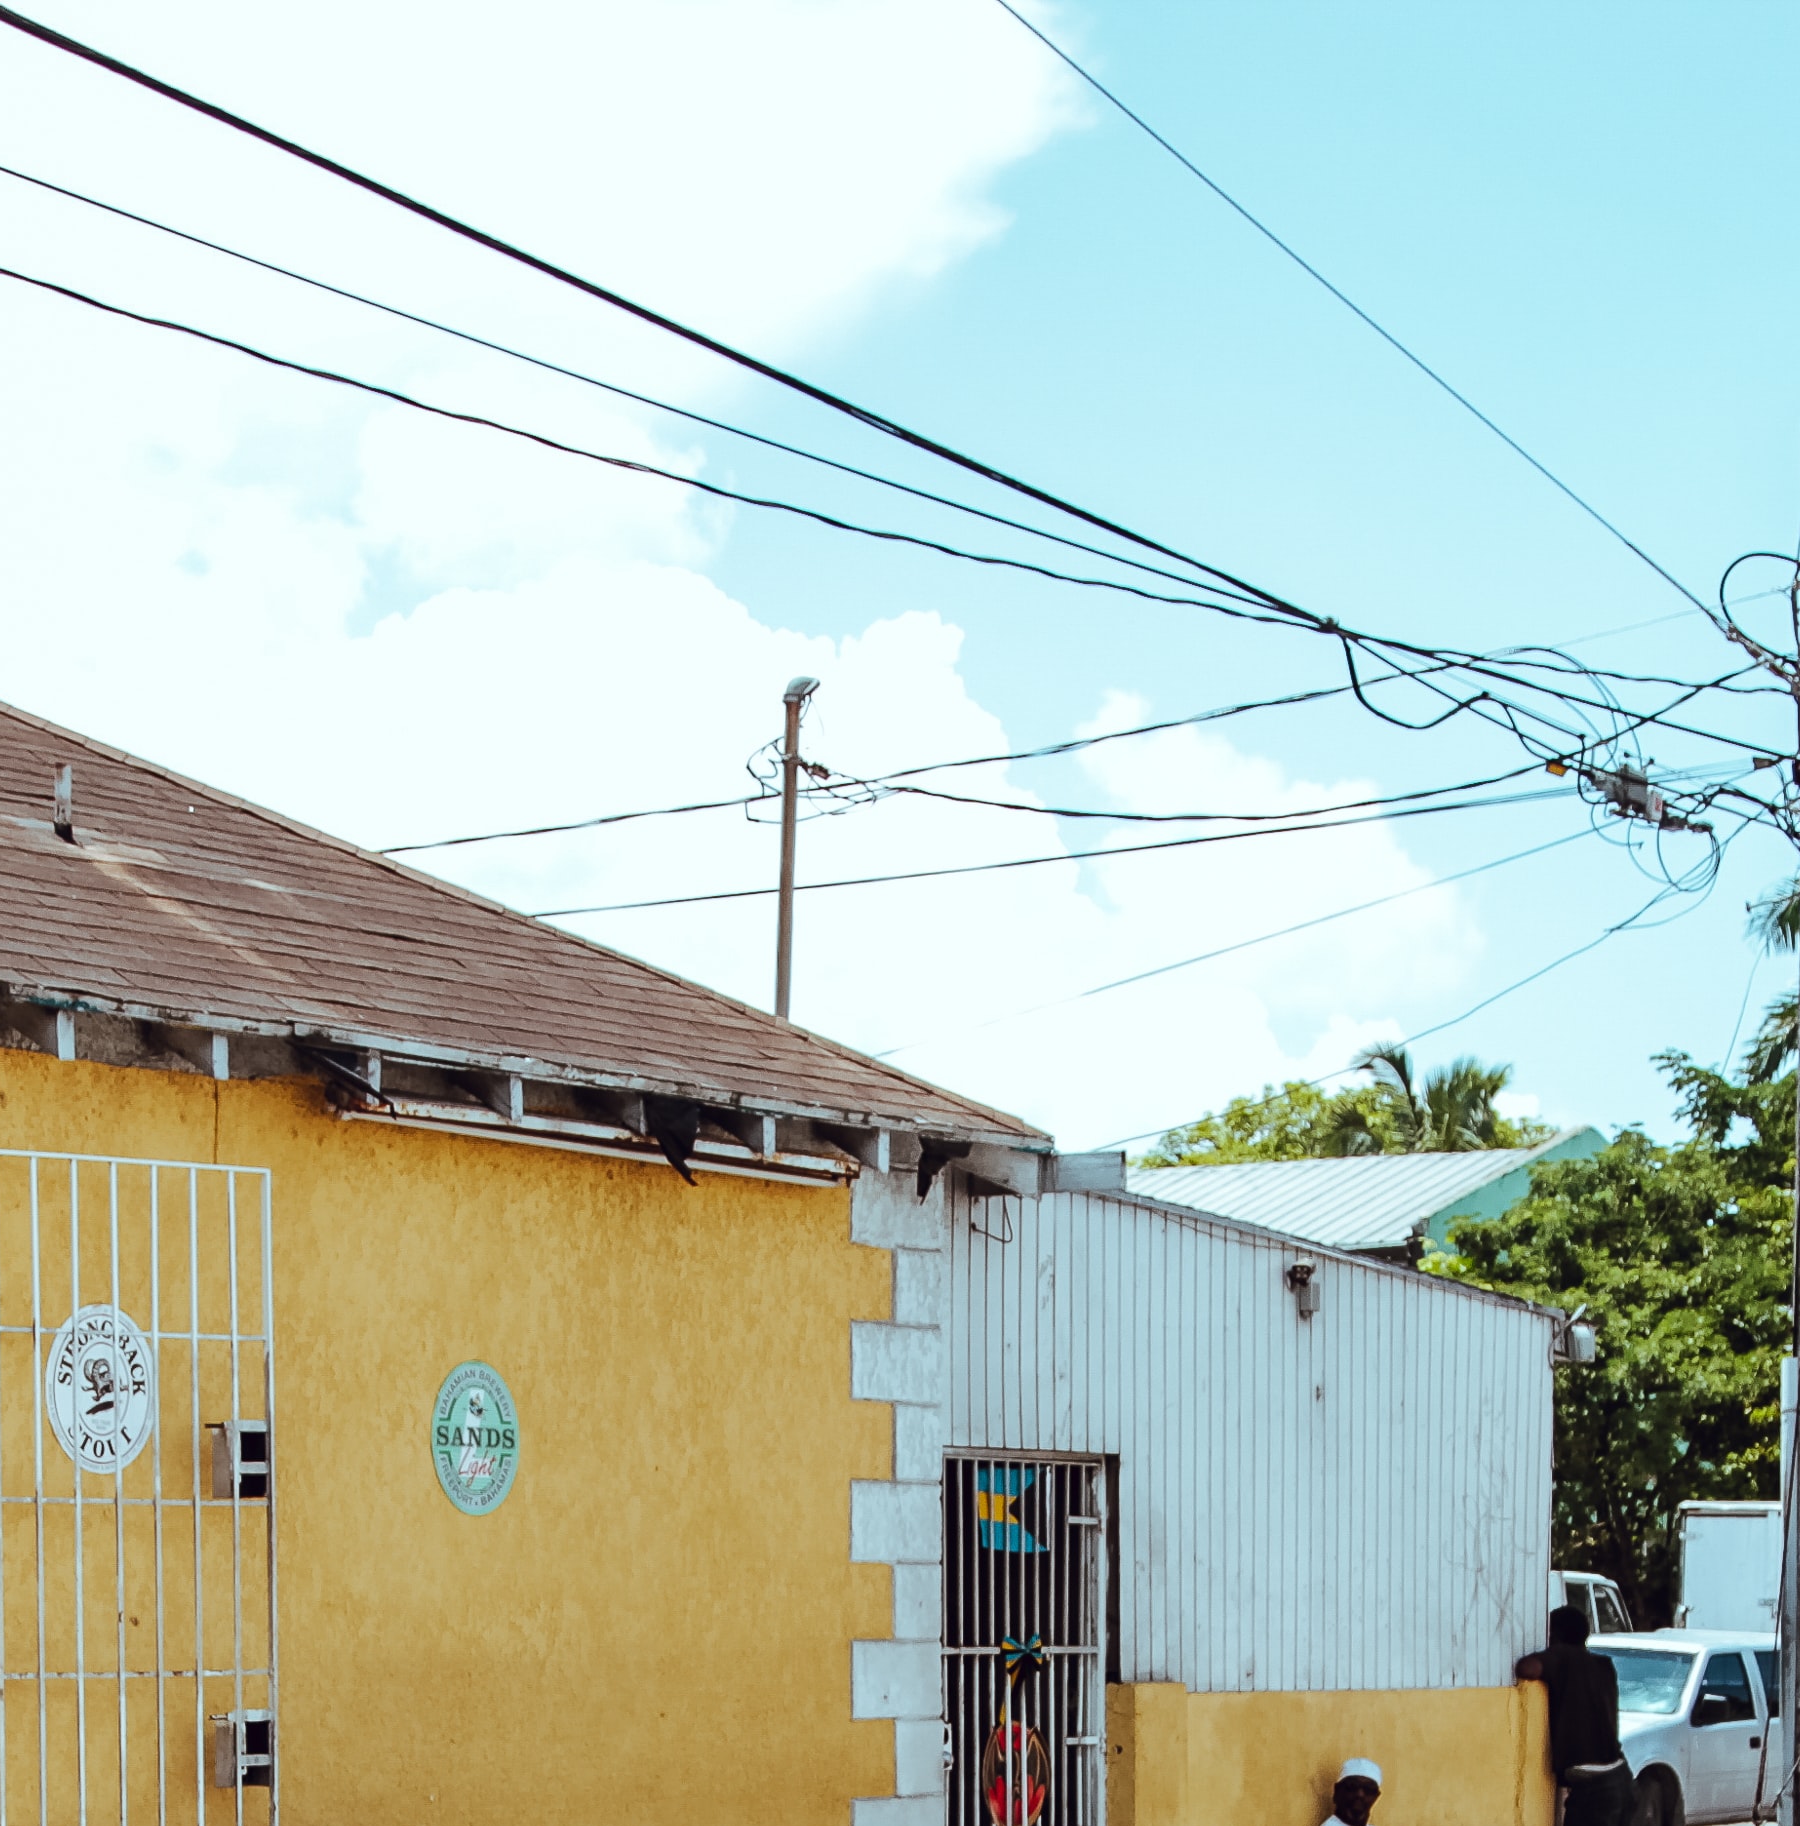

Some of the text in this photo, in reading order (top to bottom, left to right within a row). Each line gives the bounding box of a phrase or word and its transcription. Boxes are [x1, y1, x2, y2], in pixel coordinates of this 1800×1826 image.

[440, 1369, 512, 1418] BAHAMIAN BREWERY
[436, 1425, 515, 1450] SANDS
[440, 1456, 512, 1507] FREEPORT BAHAMAS
[458, 1448, 497, 1489] Light
